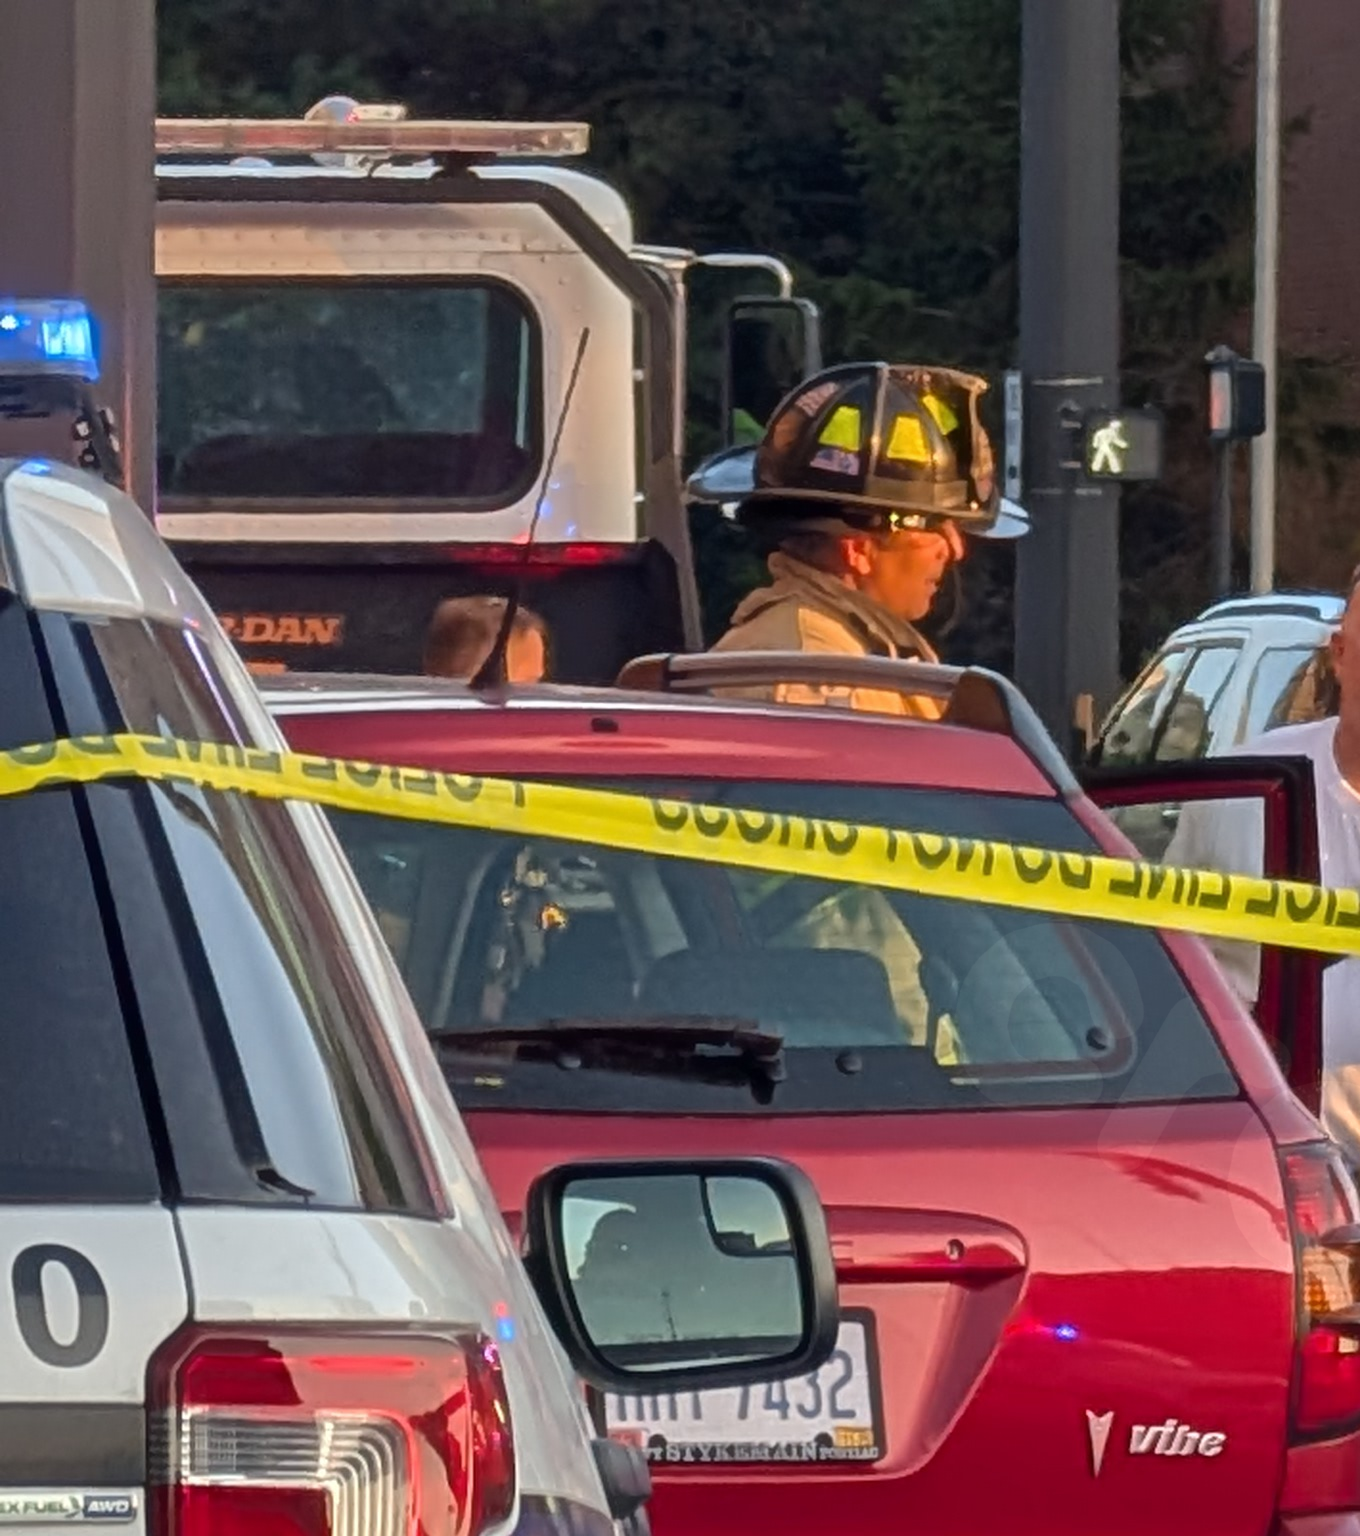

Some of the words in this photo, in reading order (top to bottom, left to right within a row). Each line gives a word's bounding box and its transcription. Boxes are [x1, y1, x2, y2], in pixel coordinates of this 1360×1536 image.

[12, 1243, 110, 1368] 0
[23, 1500, 69, 1514] FUEL
[87, 1499, 130, 1513] AWD
